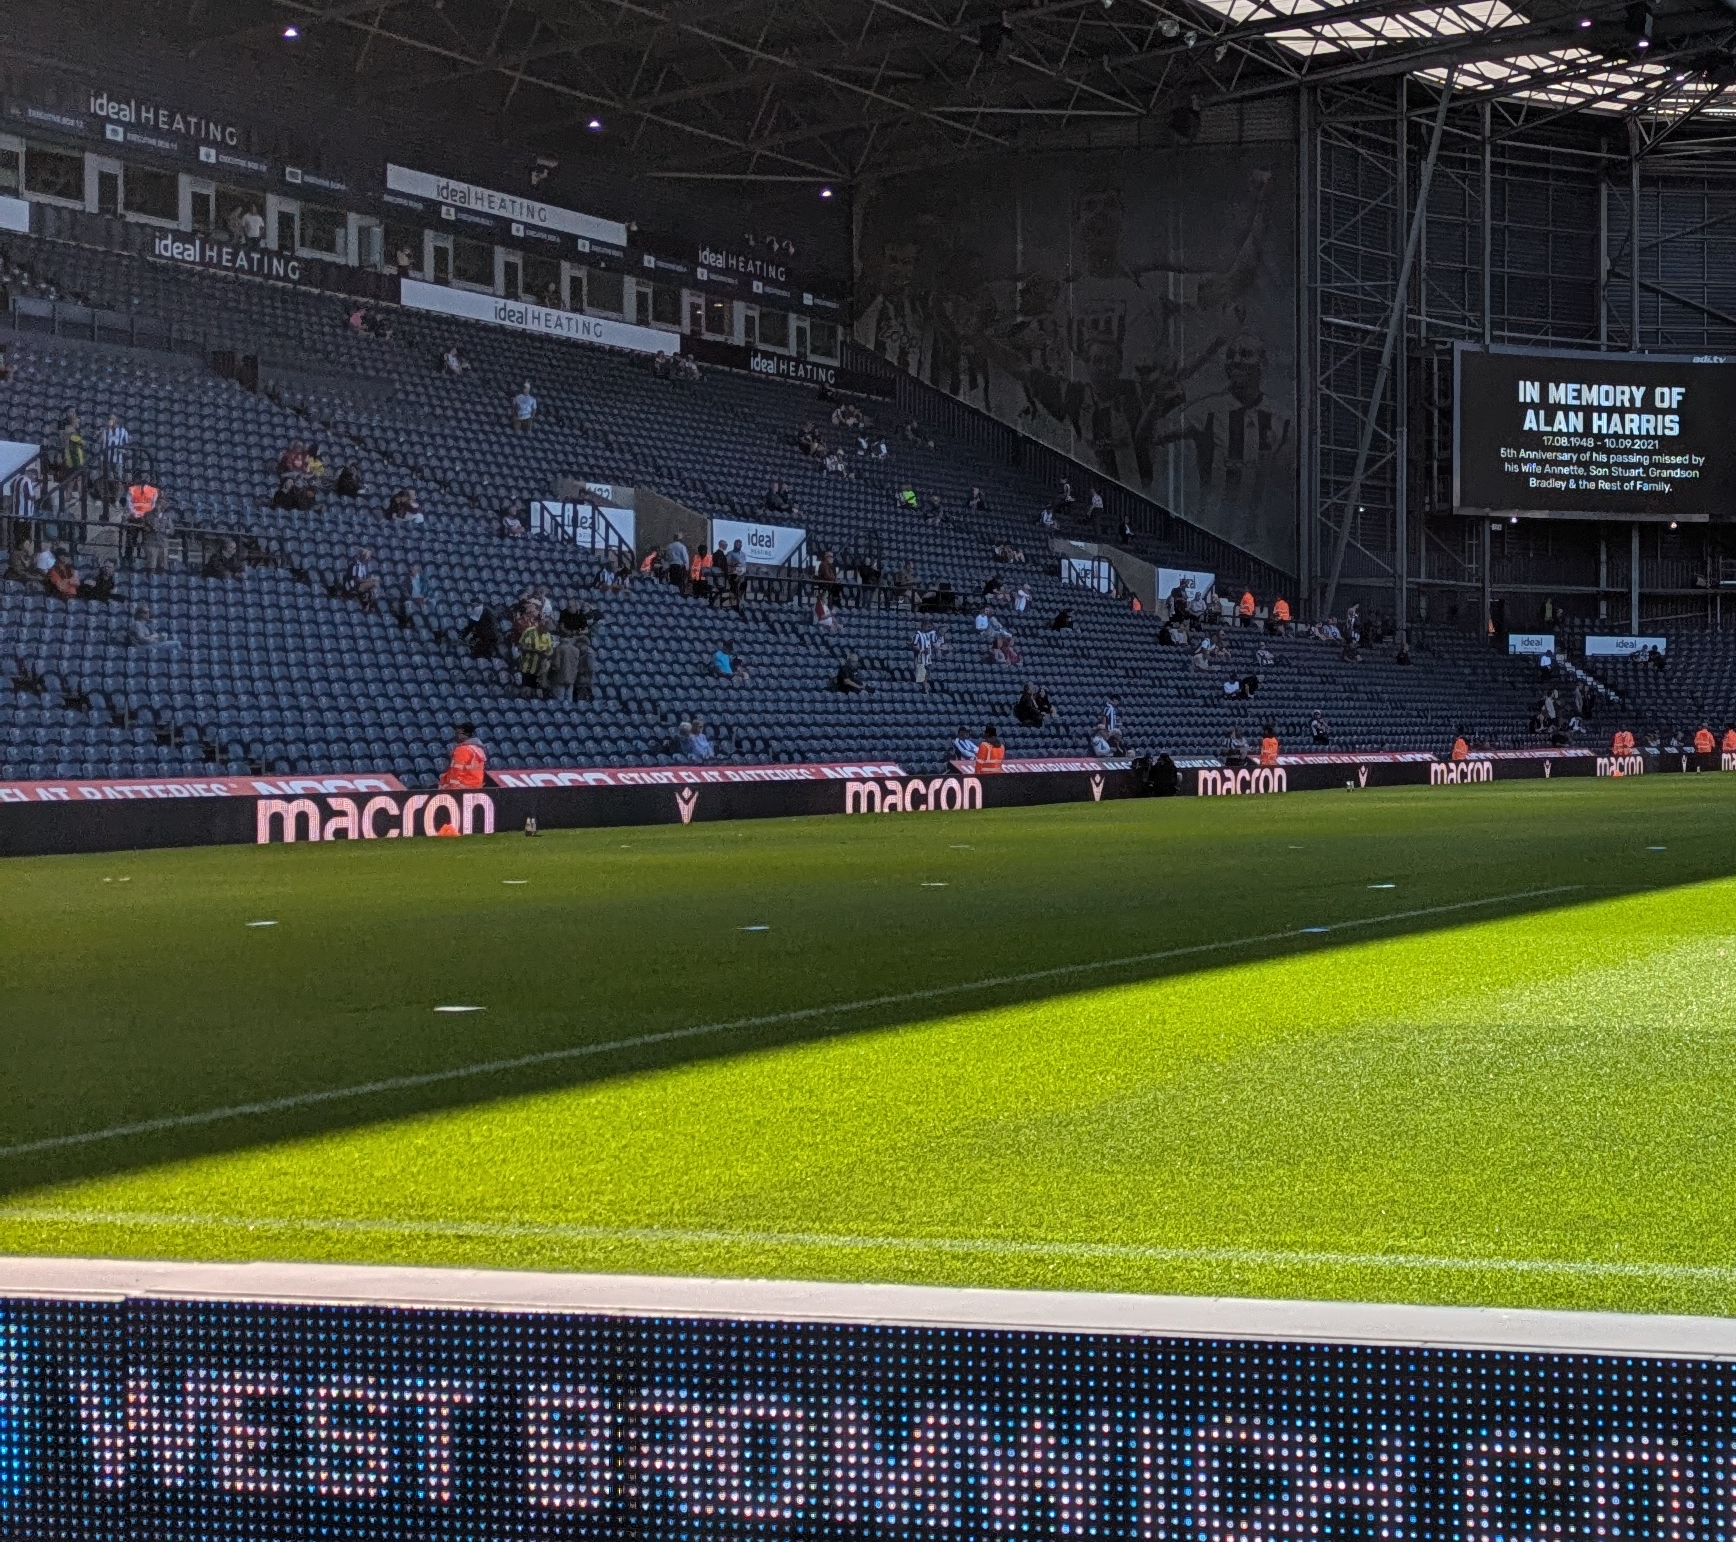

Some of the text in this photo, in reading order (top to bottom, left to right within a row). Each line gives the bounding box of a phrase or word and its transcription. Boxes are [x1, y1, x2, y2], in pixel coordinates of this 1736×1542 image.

[90, 91, 136, 124] ideal
[141, 106, 238, 146] HEATING
[437, 181, 470, 205] ideal
[475, 190, 547, 223] HEATING
[155, 232, 301, 281] ideal HEATING
[699, 247, 726, 269] ideal
[728, 255, 787, 282] HEATING
[494, 302, 603, 338] ideal HEATING
[750, 353, 836, 384] ideal HEATING
[1518, 380, 1686, 408] IN MEMORY OF
[1523, 409, 1680, 436] ALAN HARRIS
[1542, 436, 1594, 447] 17.08.1948
[1604, 438, 1659, 449] 10.09.2021
[1500, 448, 1705, 466] 5th Anniversary of his passing missed by
[1505, 462, 1519, 472] his
[1521, 463, 1542, 473] Wife
[1590, 465, 1609, 476] Son
[1648, 467, 1699, 478] Grandson
[1529, 478, 1567, 490] Bradley
[1569, 479, 1576, 488] &
[1578, 479, 1596, 489] the
[1598, 480, 1621, 491] Rest
[1623, 481, 1634, 491] of
[747, 528, 775, 549] ideal
[1521, 637, 1543, 647] ideal
[1615, 639, 1637, 649] ideal
[1431, 760, 1493, 786] macron
[1596, 755, 1644, 777] macron
[846, 766, 983, 815] macron
[1198, 766, 1288, 797] macron
[257, 792, 495, 845] macron
[69, 1365, 480, 1505] WEST
